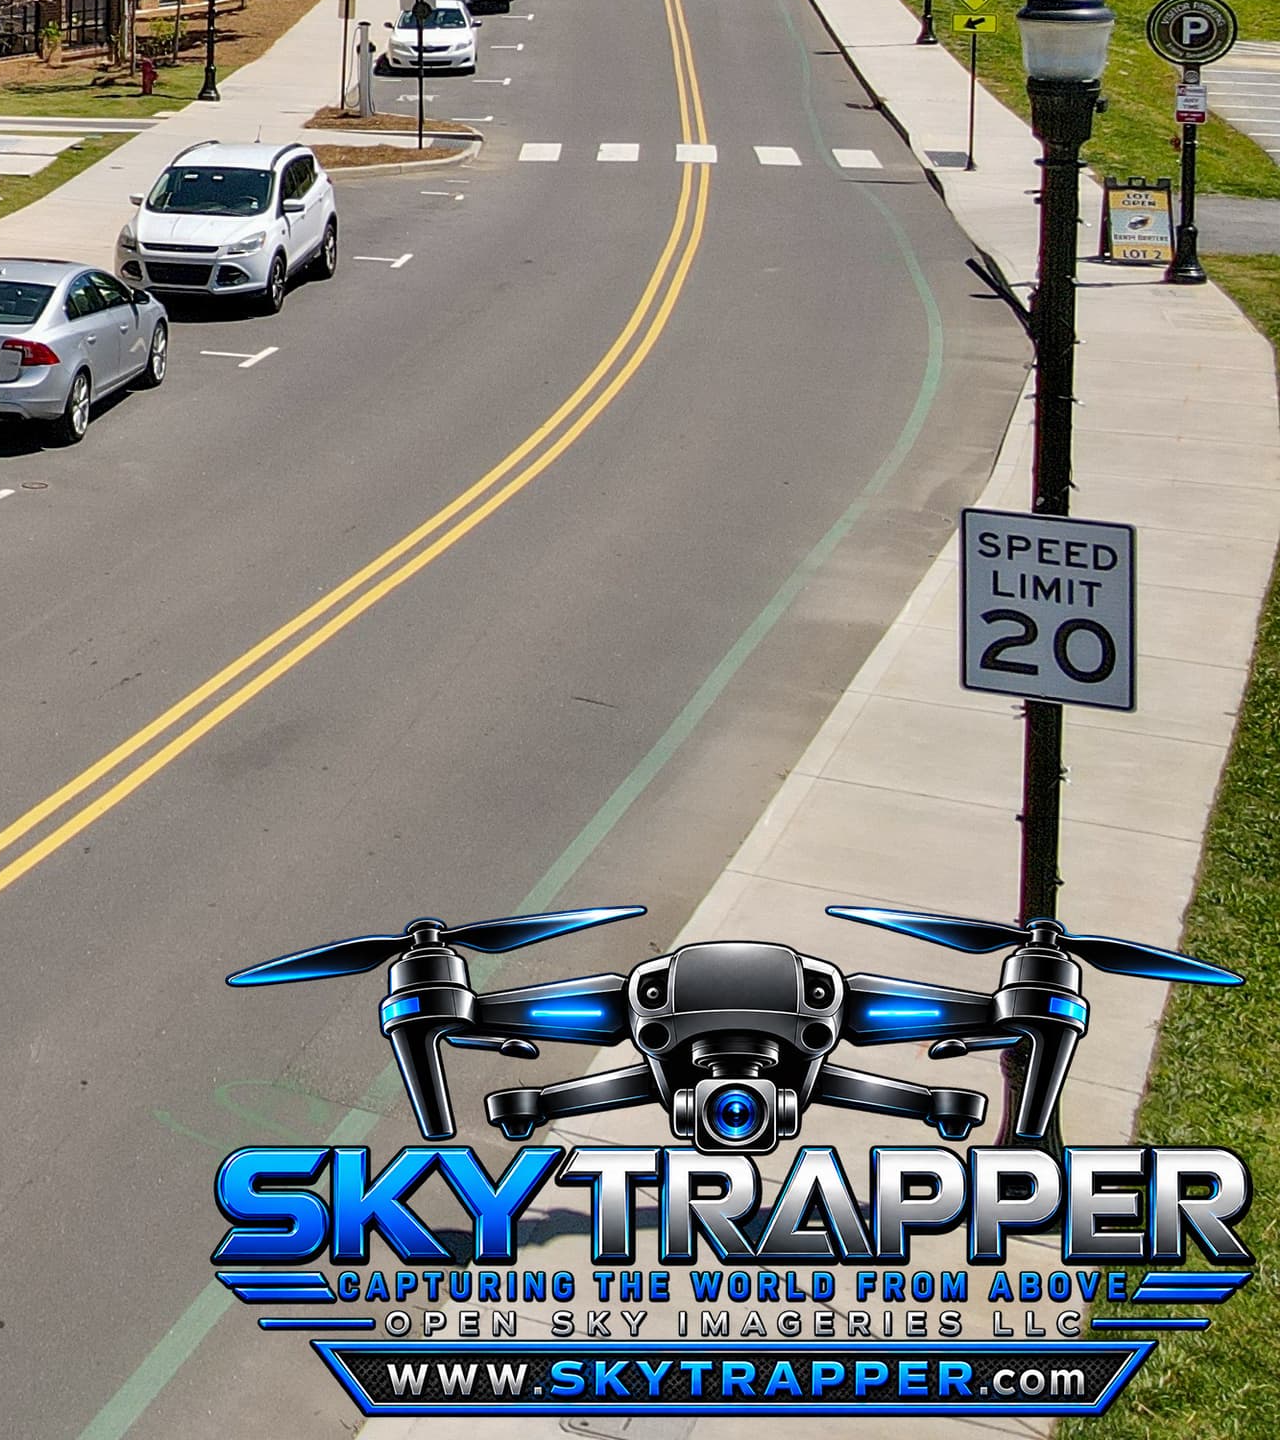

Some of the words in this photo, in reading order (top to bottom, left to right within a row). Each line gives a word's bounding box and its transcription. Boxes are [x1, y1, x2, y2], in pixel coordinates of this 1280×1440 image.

[1182, 16, 1209, 45] P
[1123, 249, 1149, 259] LOT
[1152, 250, 1162, 260] 2
[977, 532, 1118, 571] SPEED
[992, 570, 1102, 607] LIMIT
[980, 608, 1117, 684] 20
